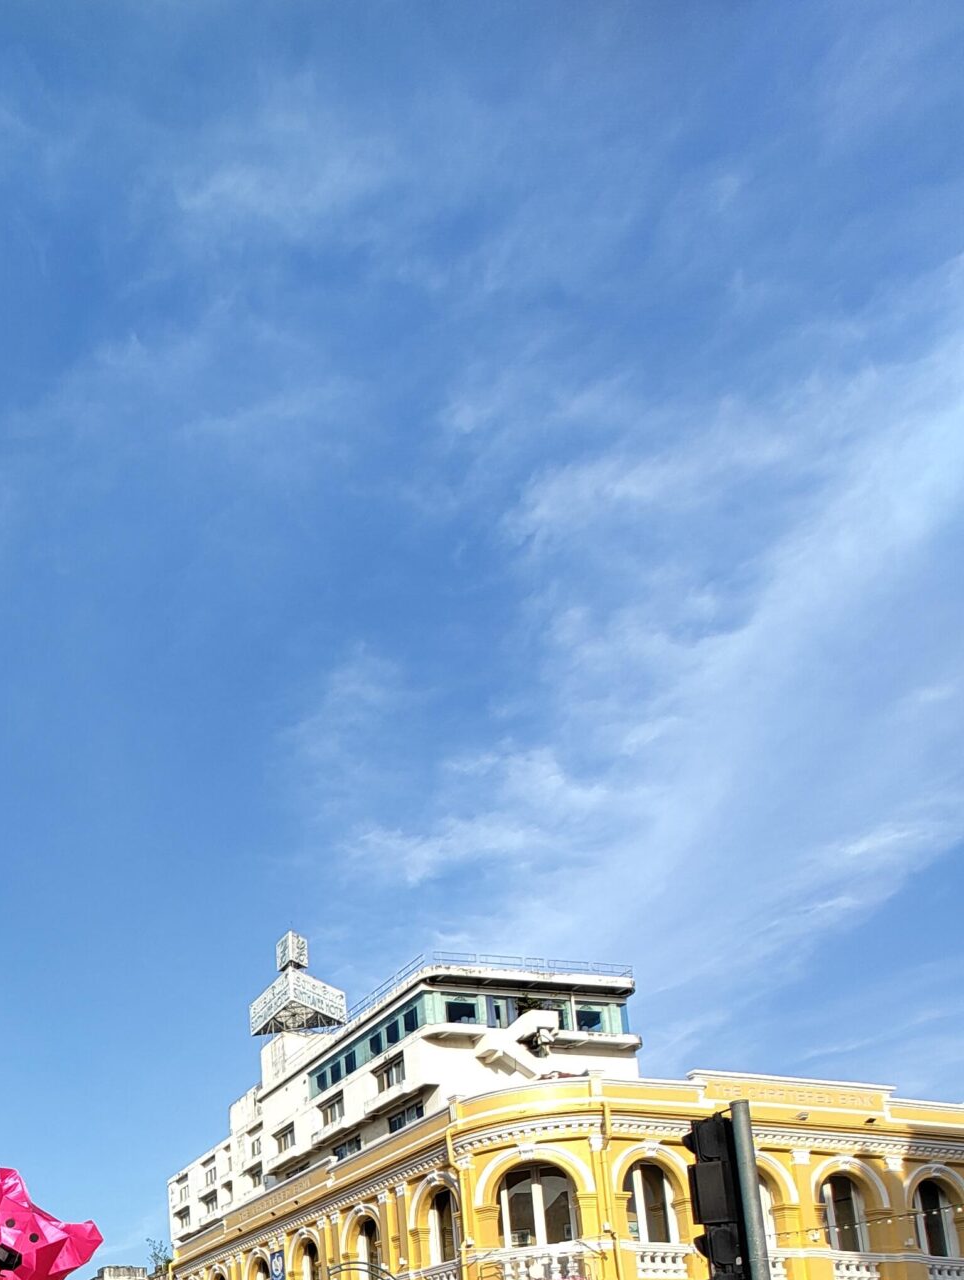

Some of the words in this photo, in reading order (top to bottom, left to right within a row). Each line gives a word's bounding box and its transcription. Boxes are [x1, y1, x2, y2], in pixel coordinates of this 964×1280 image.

[713, 1083, 742, 1097] THE
[748, 1087, 835, 1104] CHARTERED
[840, 1093, 875, 1107] BANK
